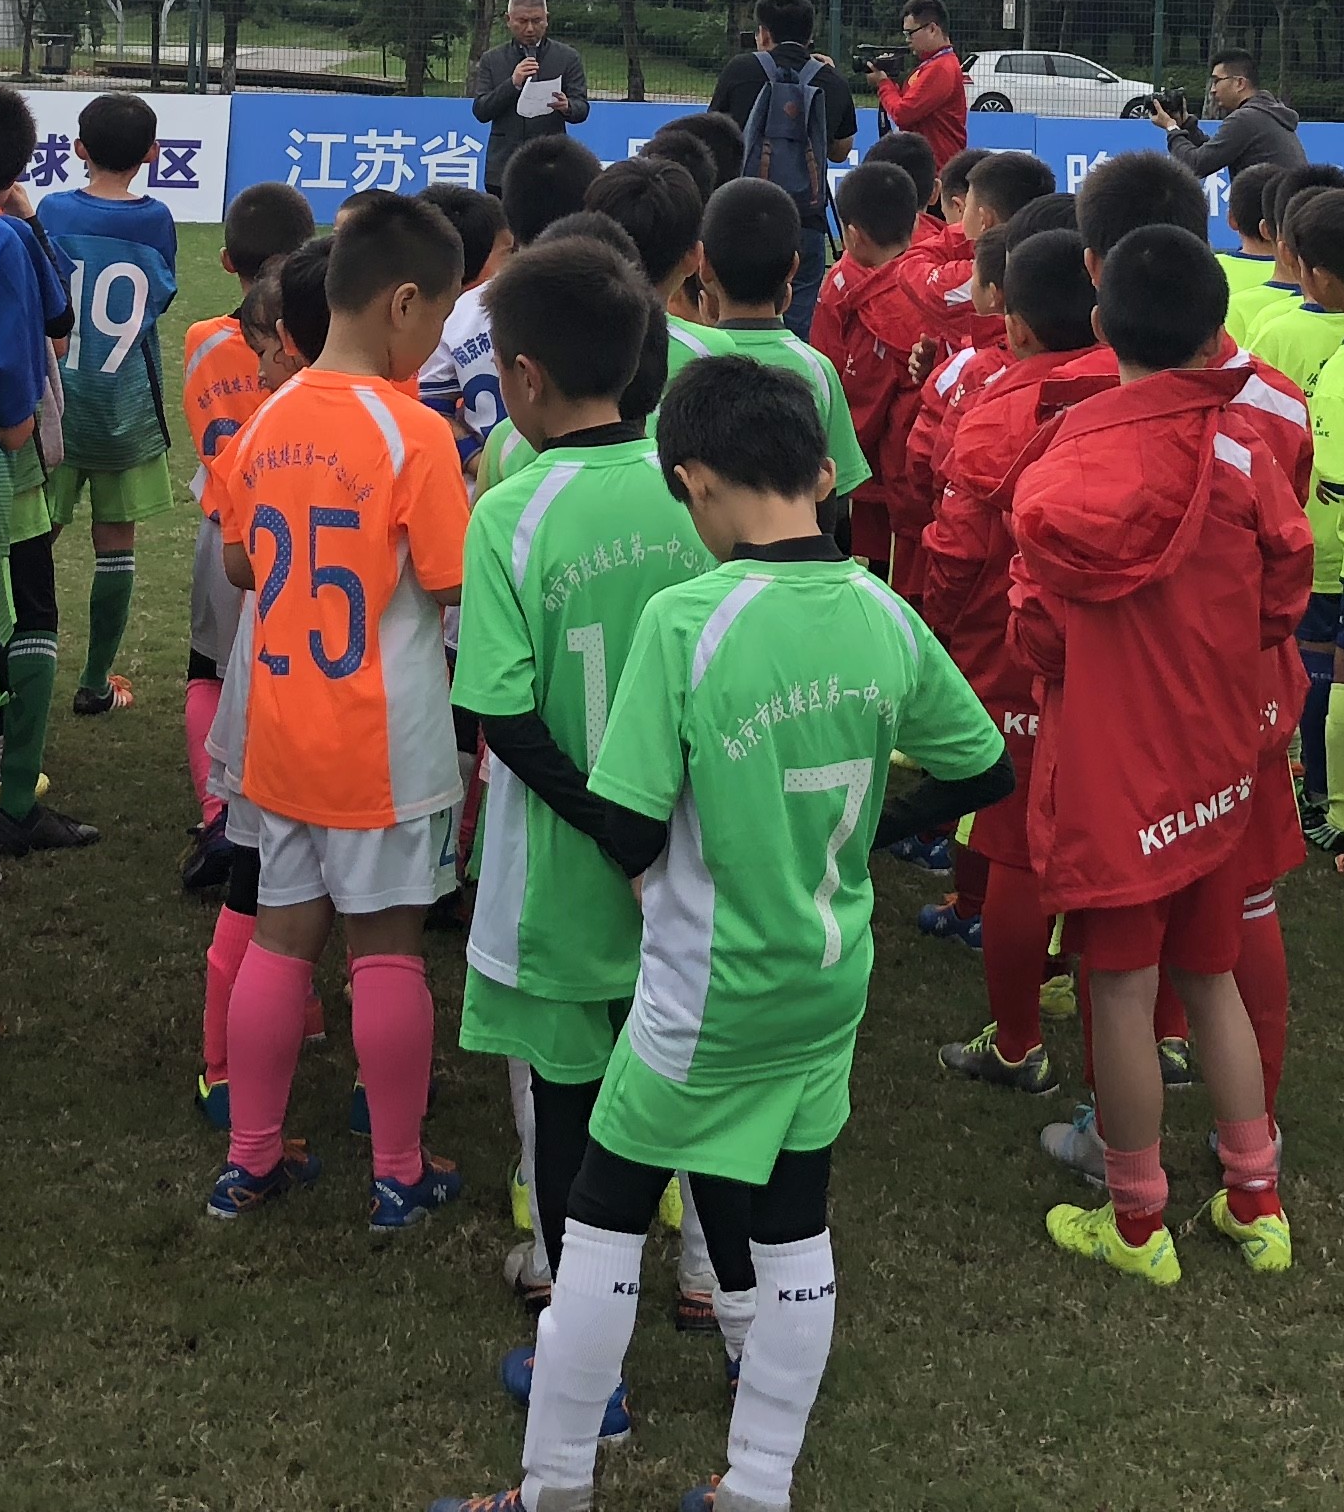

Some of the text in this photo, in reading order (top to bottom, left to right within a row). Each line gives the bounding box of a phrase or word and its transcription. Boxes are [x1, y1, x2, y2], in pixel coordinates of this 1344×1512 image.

[64, 260, 149, 373] 19
[250, 503, 365, 680] 25
[784, 757, 873, 969] 7
[1138, 784, 1235, 856] KELME
